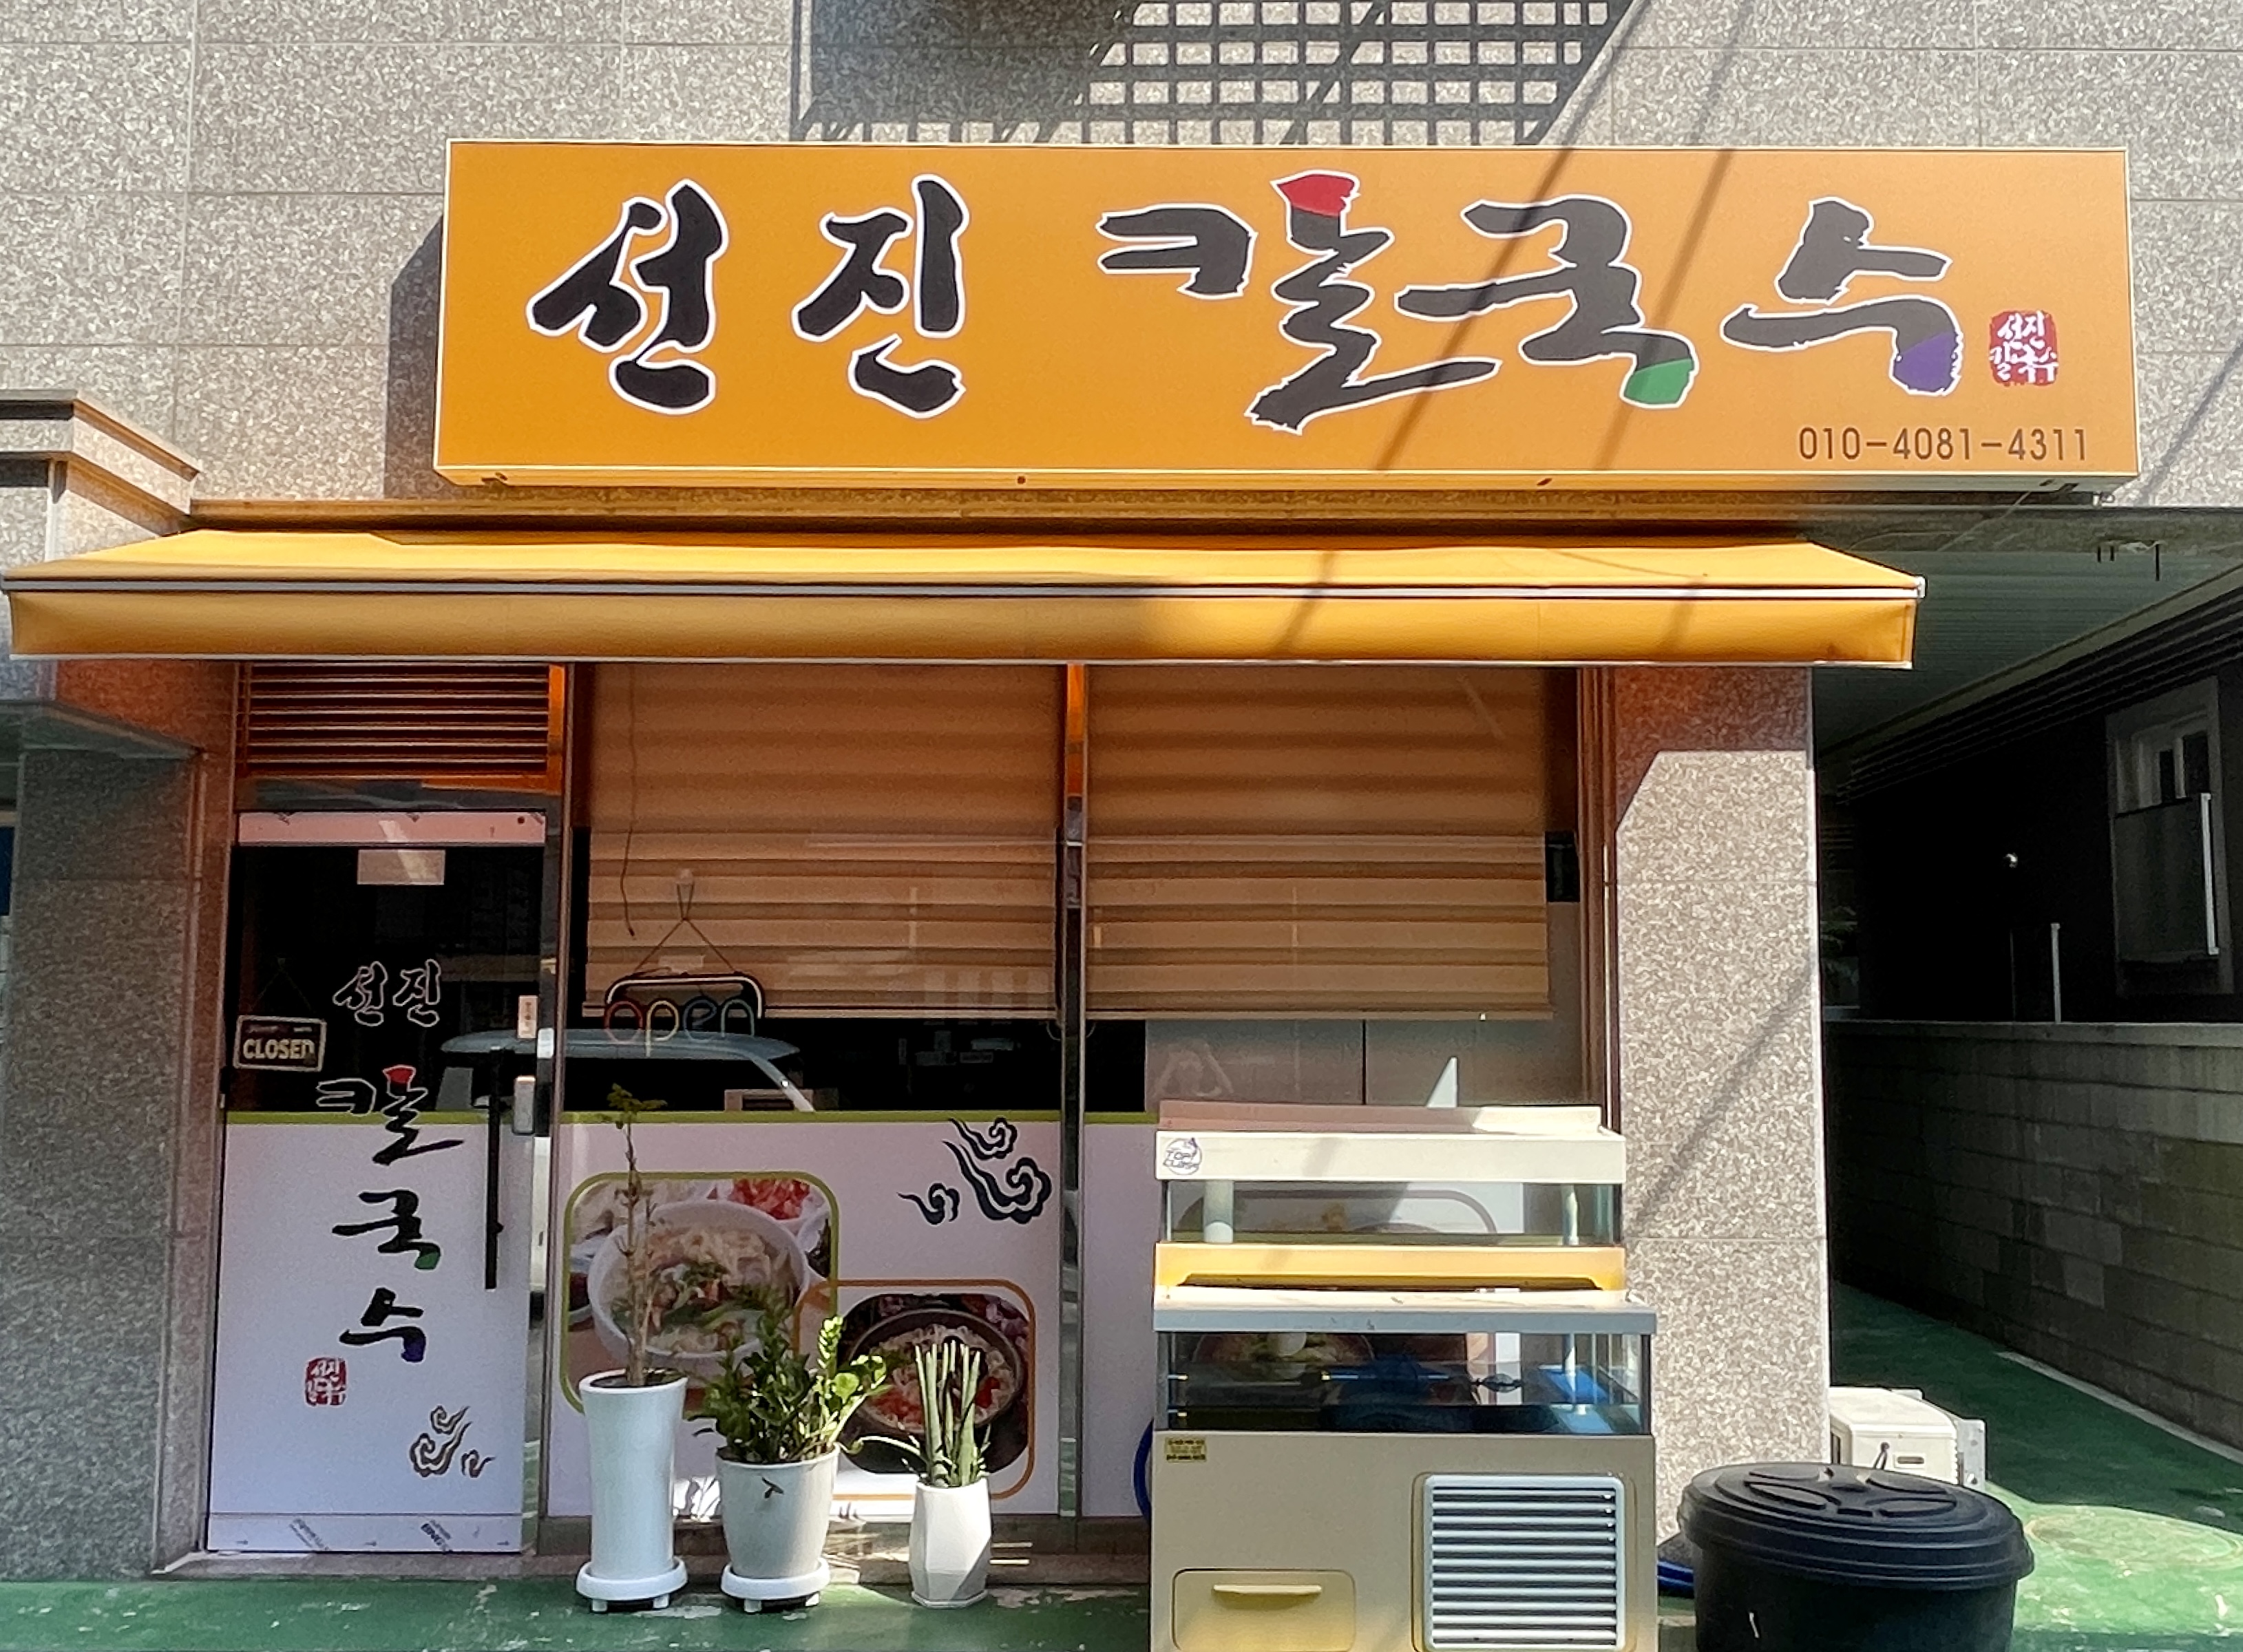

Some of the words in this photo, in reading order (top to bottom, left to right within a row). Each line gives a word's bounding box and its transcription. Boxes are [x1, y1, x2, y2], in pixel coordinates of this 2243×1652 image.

[527, 178, 969, 419] 선진
[1097, 170, 1963, 435] 칼국수
[1997, 310, 2045, 350] 선진
[1988, 342, 2059, 383] 칼국수
[1798, 427, 2087, 461] 010-4081-4311
[332, 959, 441, 1027] 선진
[603, 998, 756, 1057] open
[243, 1038, 315, 1059] CLOSED
